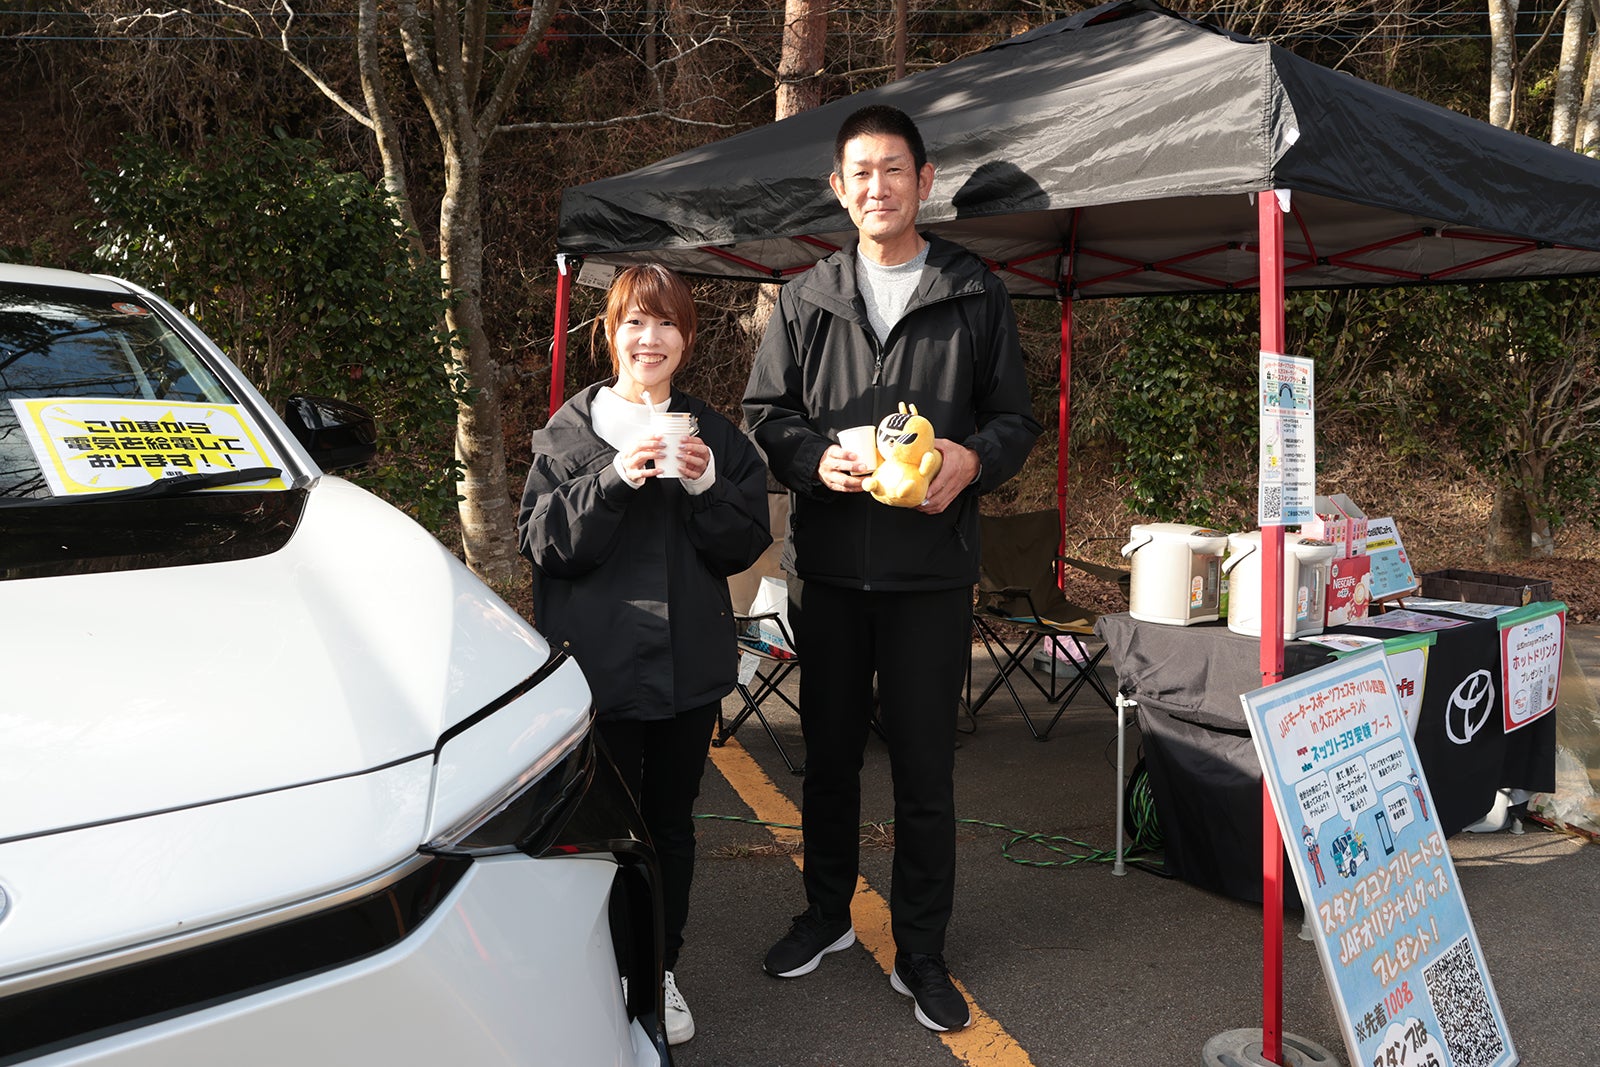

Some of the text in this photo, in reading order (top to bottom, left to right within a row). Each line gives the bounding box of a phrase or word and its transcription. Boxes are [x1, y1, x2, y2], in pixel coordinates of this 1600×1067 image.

[84, 420, 212, 434] この車から
[63, 436, 245, 451] 電気を給電して
[86, 453, 237, 468] おります！！
[1512, 643, 1557, 670] ホットドリンク
[1521, 664, 1551, 684] プレゼント！！
[1279, 679, 1387, 739] JAFモータースポーツフェスティバル四国
[1310, 698, 1367, 735] in 久万スキーランド
[1311, 714, 1393, 763] ネッツトヨタ愛媛 ブース
[1335, 771, 1367, 795] JAFモータースポーツ
[1341, 784, 1368, 804] フェスティバルを
[1319, 833, 1444, 935] スタンプコンプリートで
[1340, 867, 1449, 965] JAFオリジナルグッズ
[1372, 915, 1440, 986] プレゼント！
